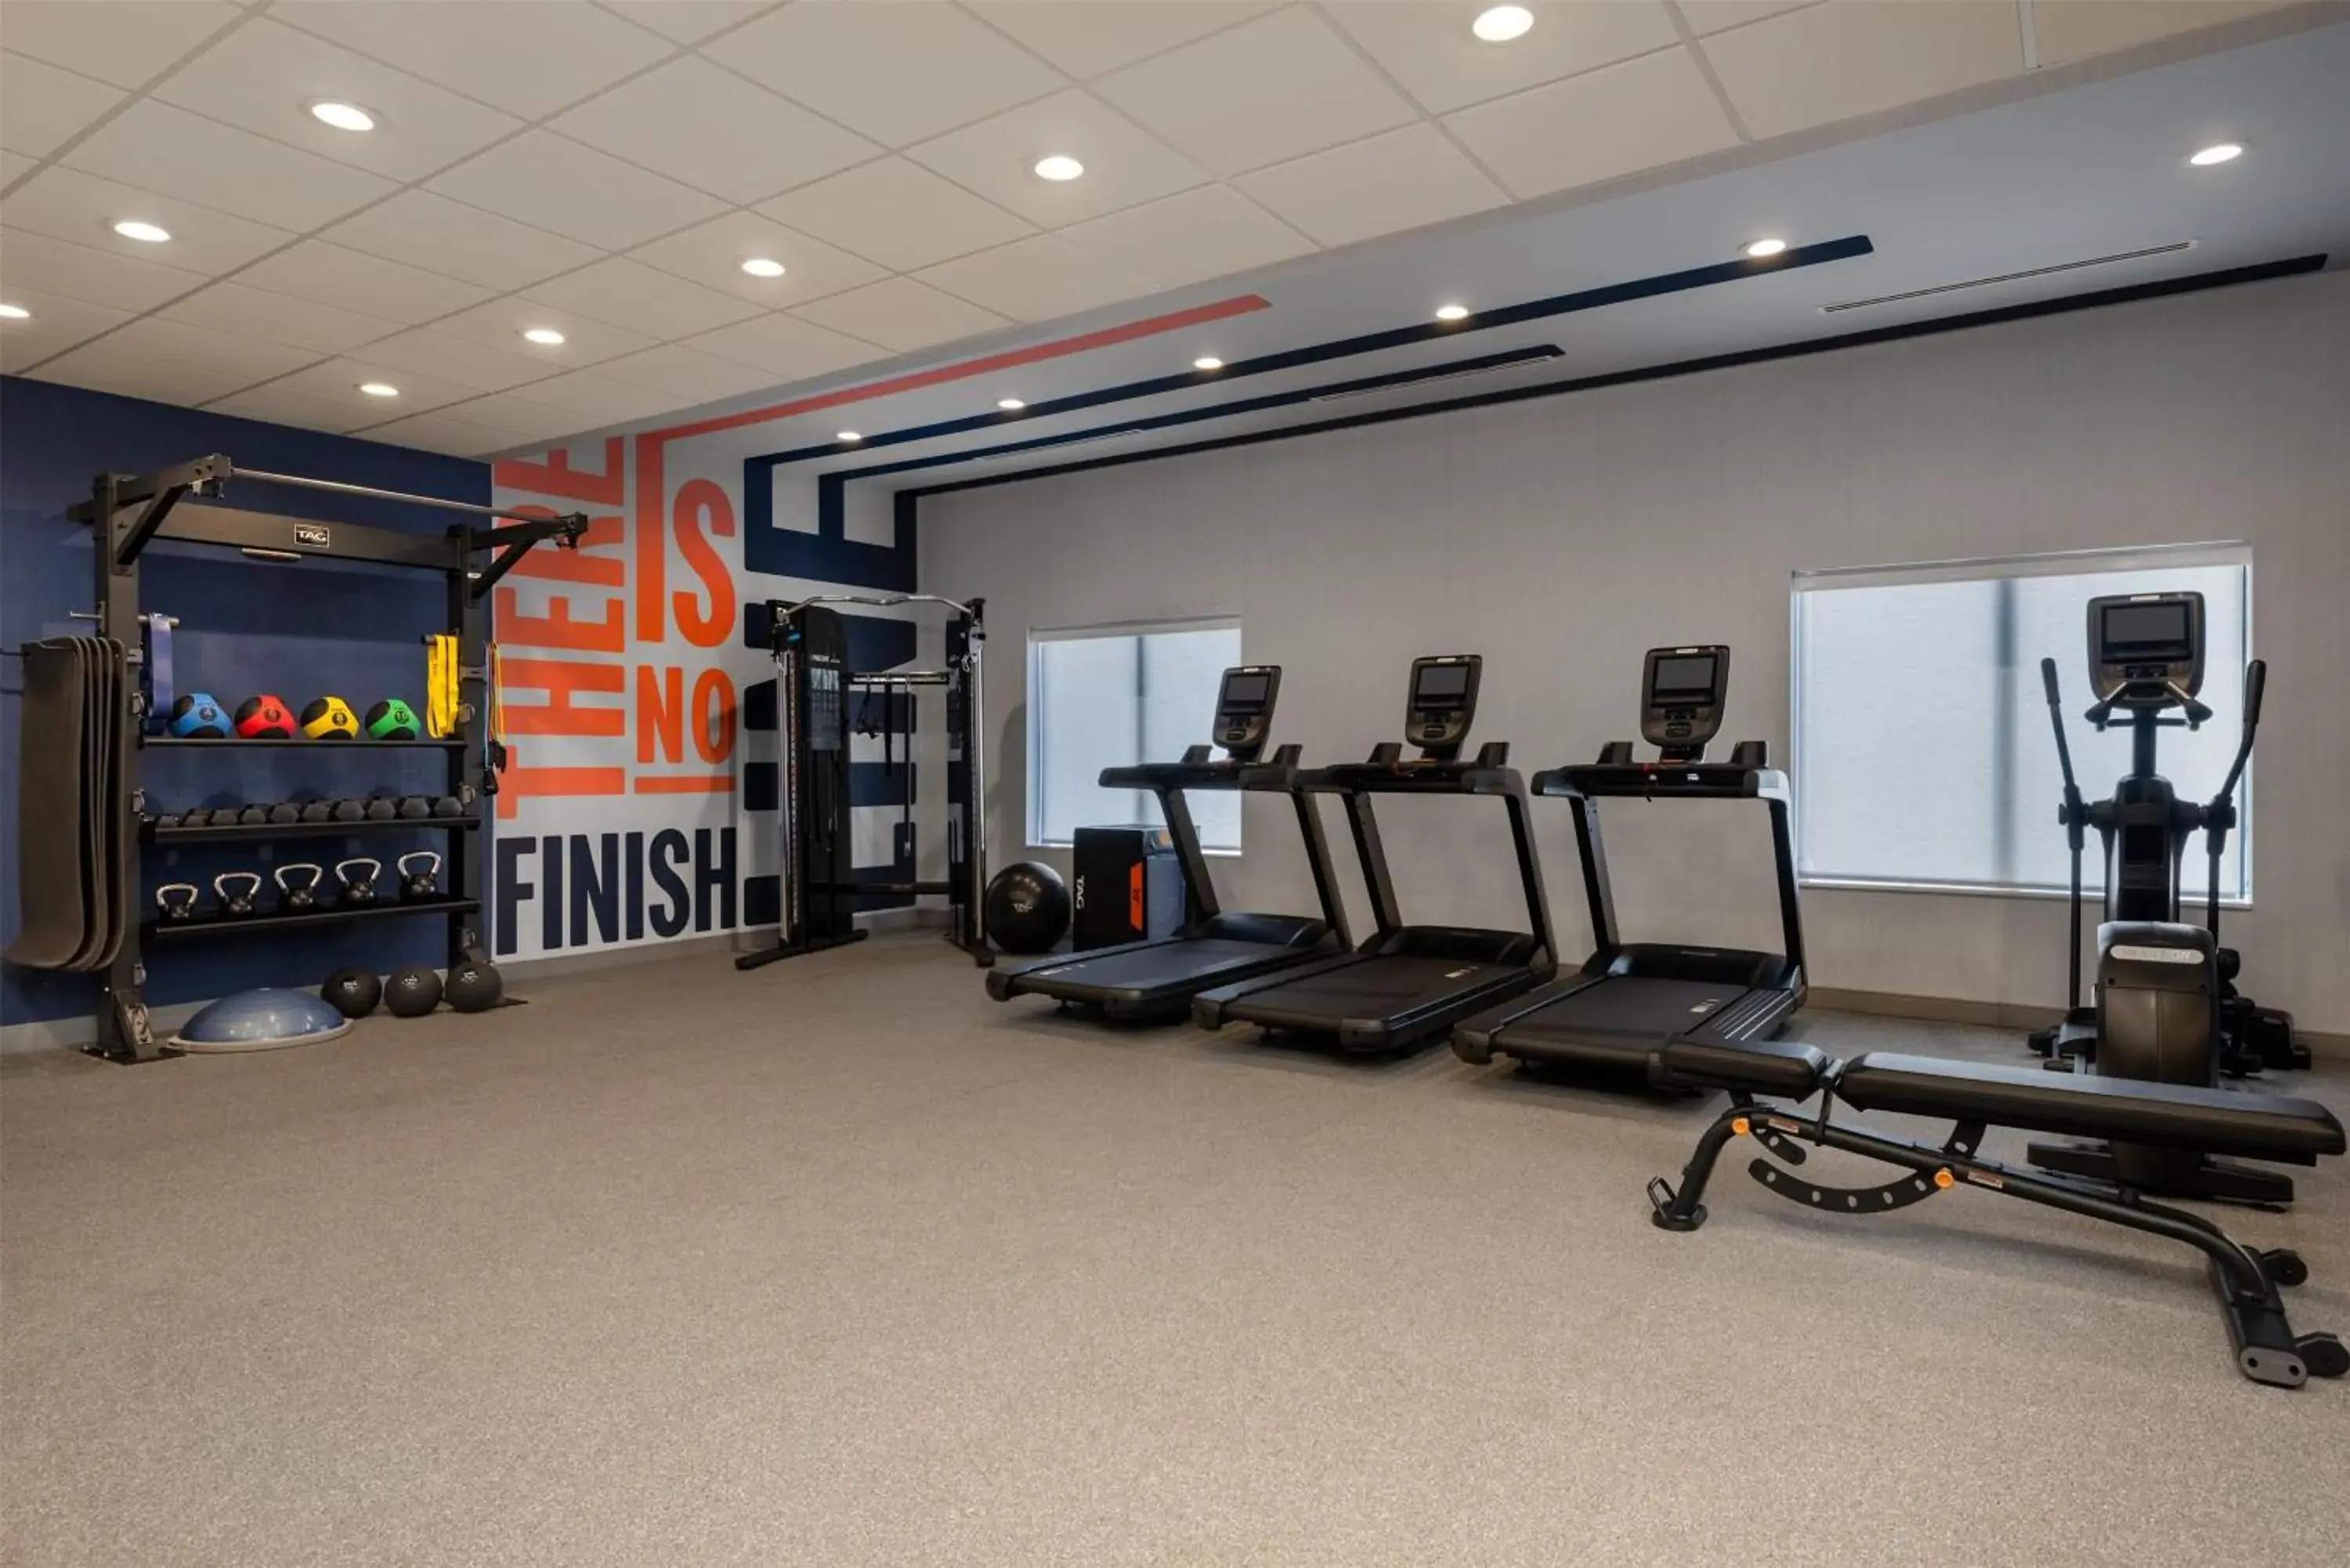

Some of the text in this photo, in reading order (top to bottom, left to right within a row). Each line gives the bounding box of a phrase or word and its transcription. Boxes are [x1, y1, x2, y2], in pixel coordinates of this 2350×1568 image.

[298, 530, 327, 543] TAG
[635, 433, 736, 648] IS
[495, 437, 624, 819] THERE
[636, 665, 737, 764] NO
[497, 827, 737, 956] FINISH
[1076, 874, 1085, 910] TAG
